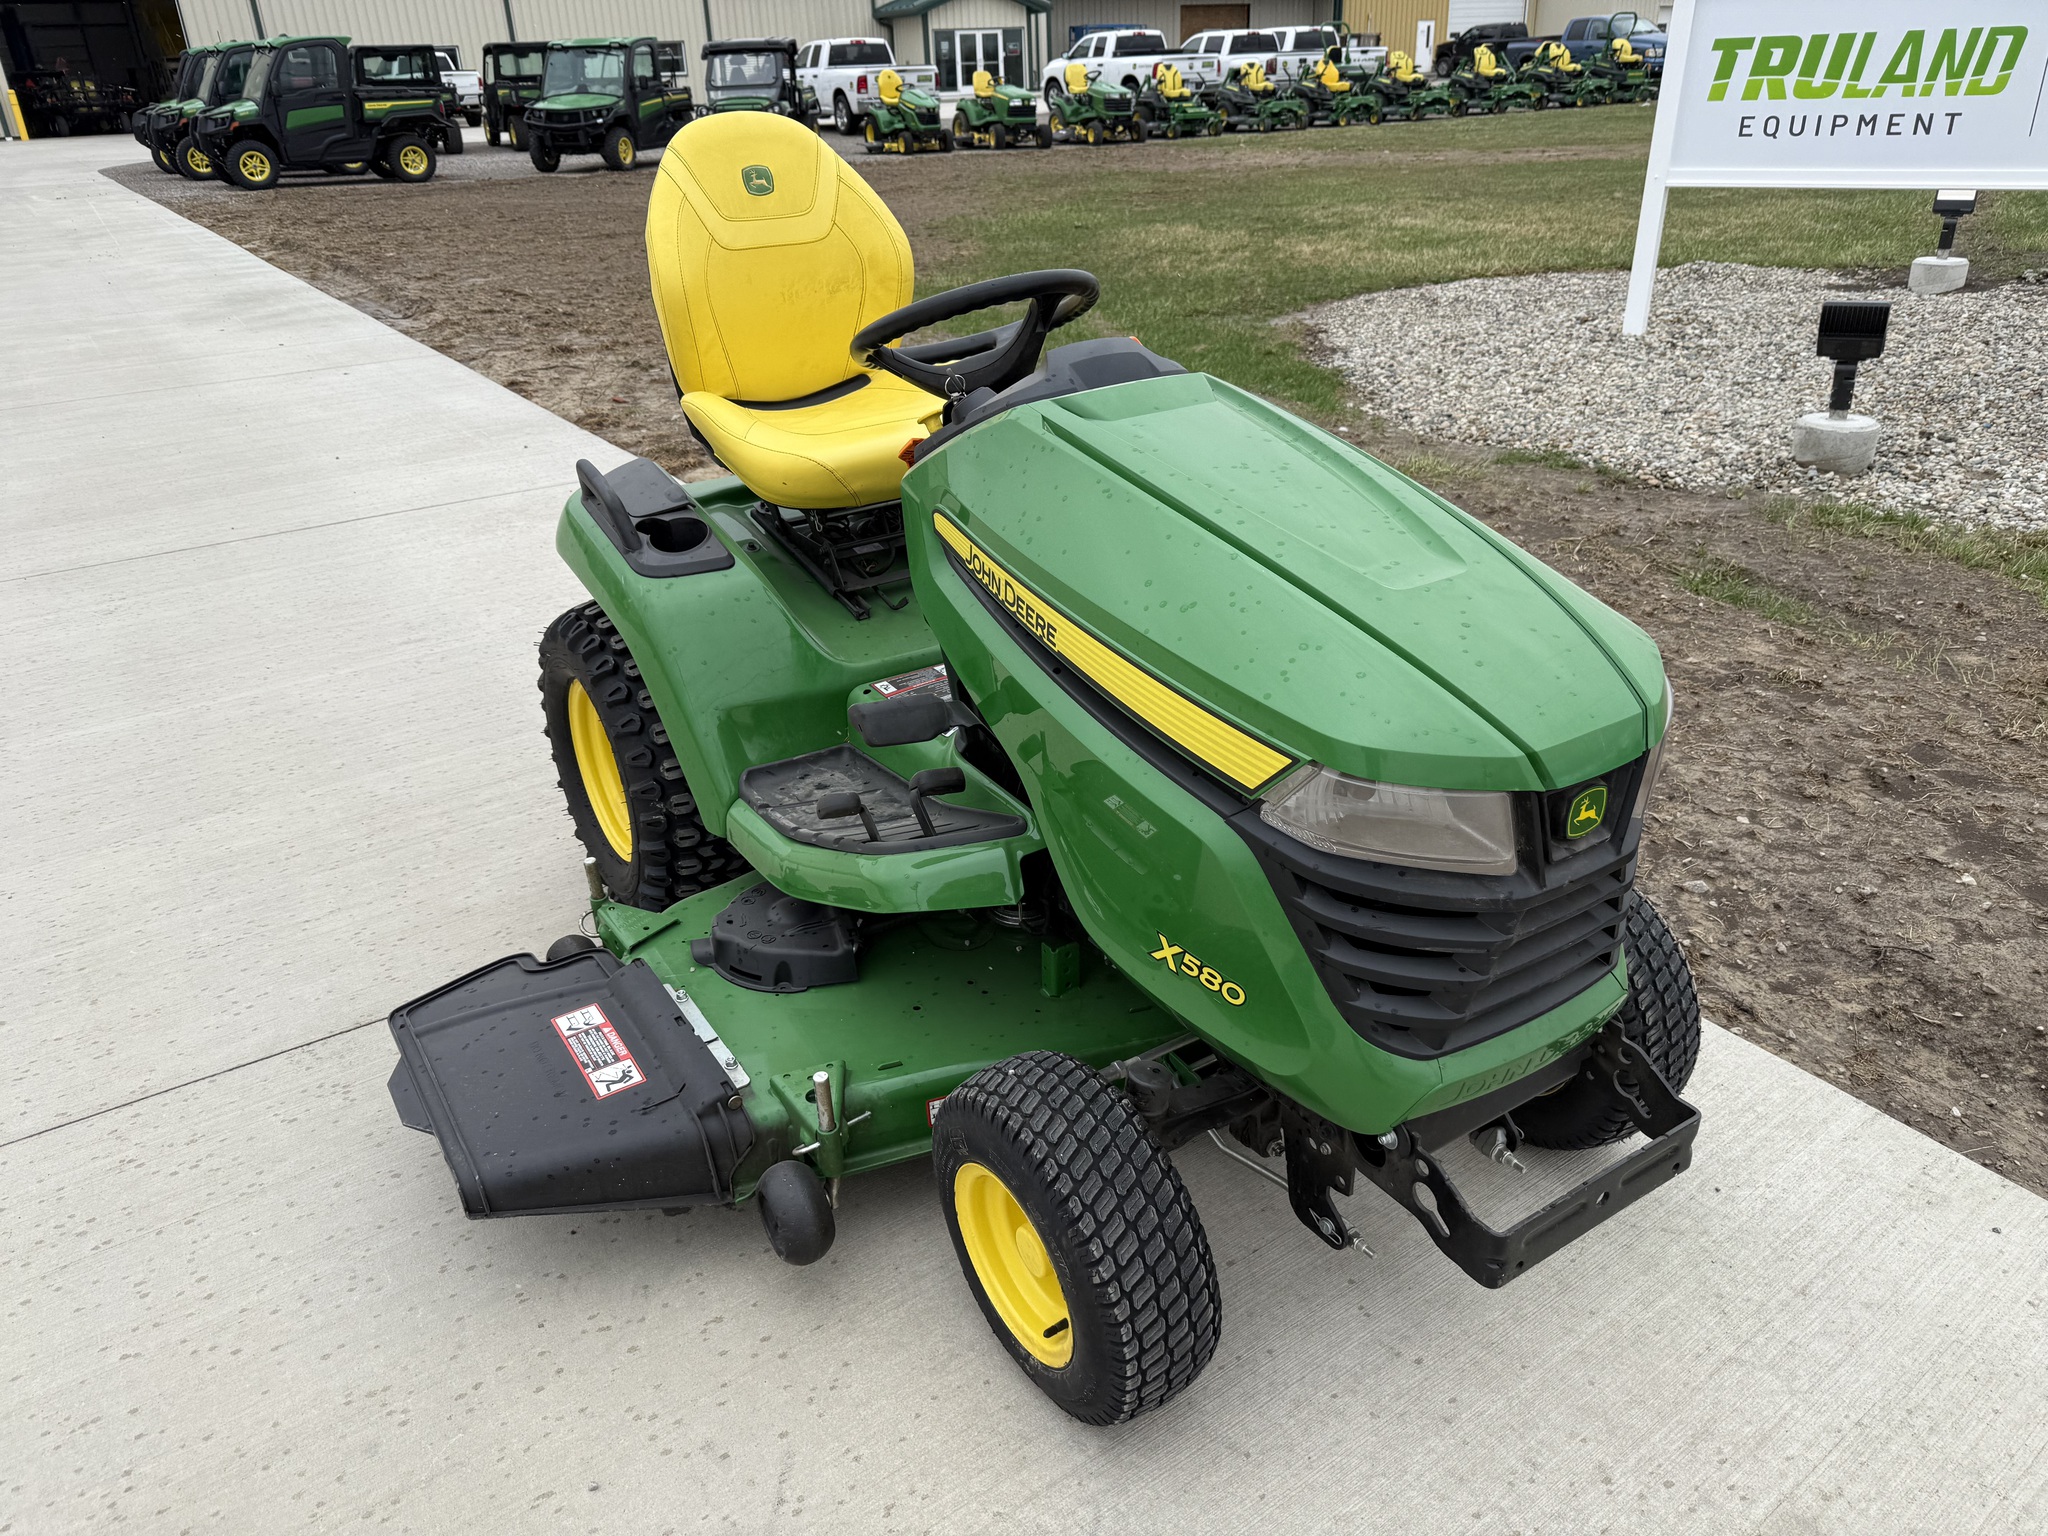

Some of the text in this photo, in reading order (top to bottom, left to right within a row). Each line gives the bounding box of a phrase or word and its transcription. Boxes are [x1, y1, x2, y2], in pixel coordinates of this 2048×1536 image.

[1706, 25, 2029, 102] TRULAND
[1738, 112, 1963, 139] EQUIPMENT
[964, 544, 1058, 649] JOHN DEERE
[1147, 929, 1247, 1007] X580
[607, 1031, 628, 1057] DANGER
